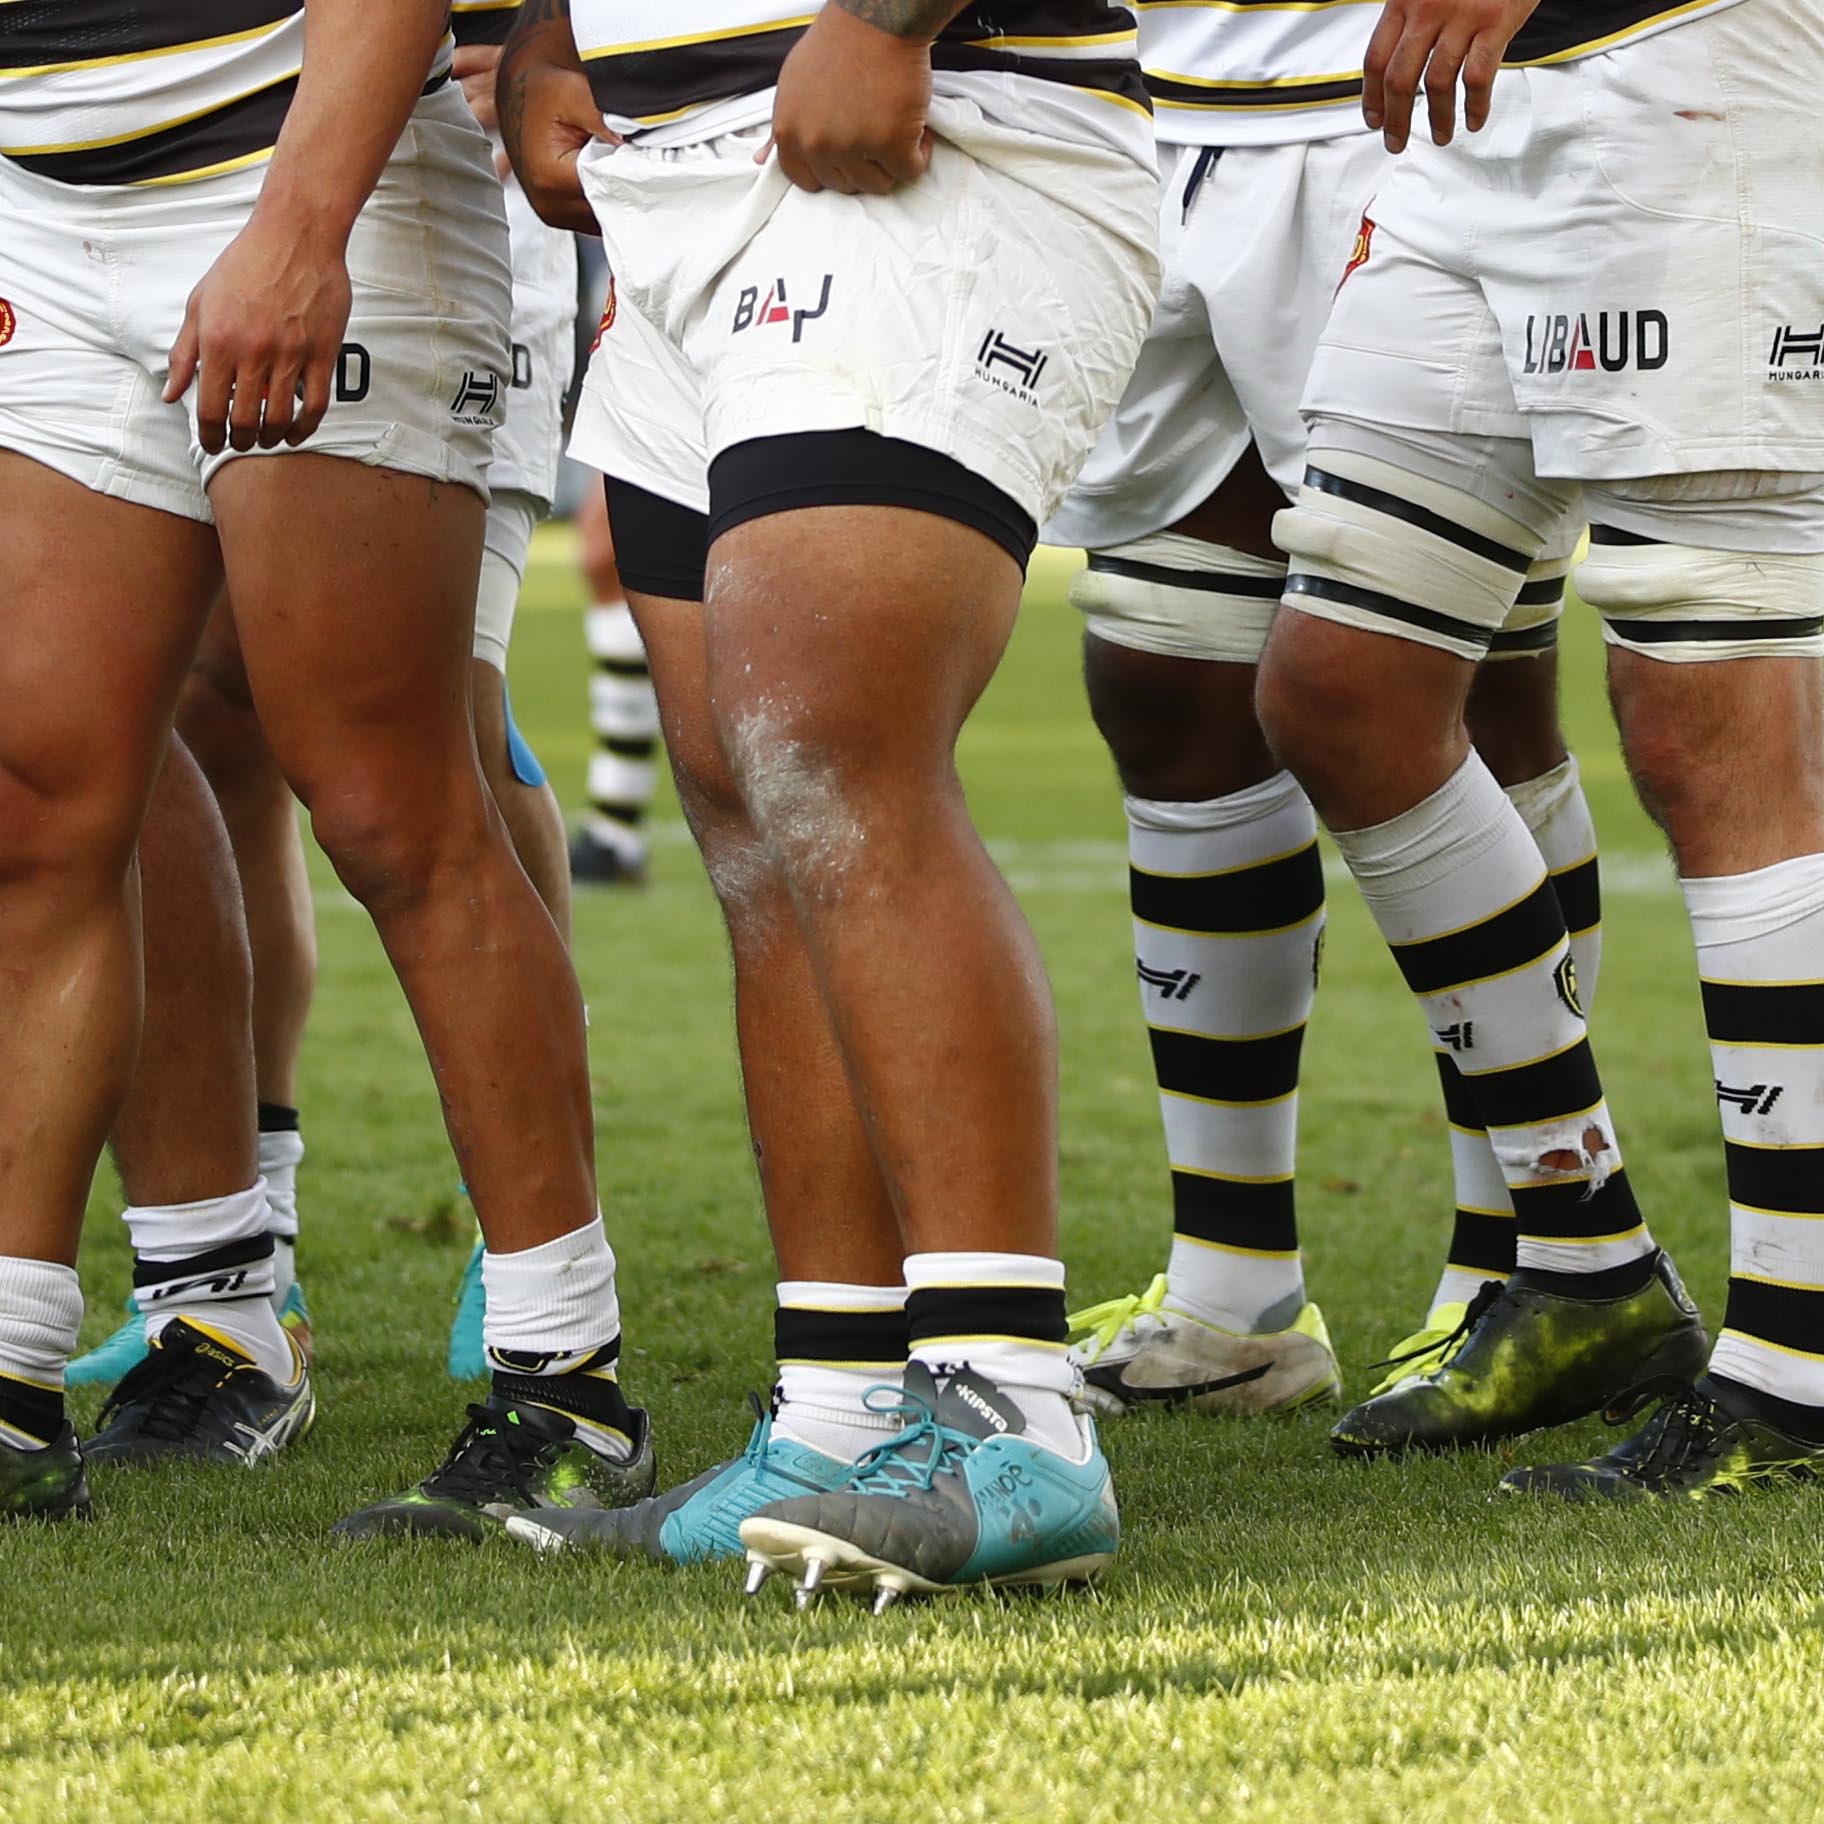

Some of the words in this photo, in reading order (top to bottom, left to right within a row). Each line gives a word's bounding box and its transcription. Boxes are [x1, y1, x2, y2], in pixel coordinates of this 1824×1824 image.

[1522, 309, 1670, 375] LIBAUD
[974, 368, 1040, 407] HUNGARIA
[955, 1382, 1009, 1433] KIPSTA
